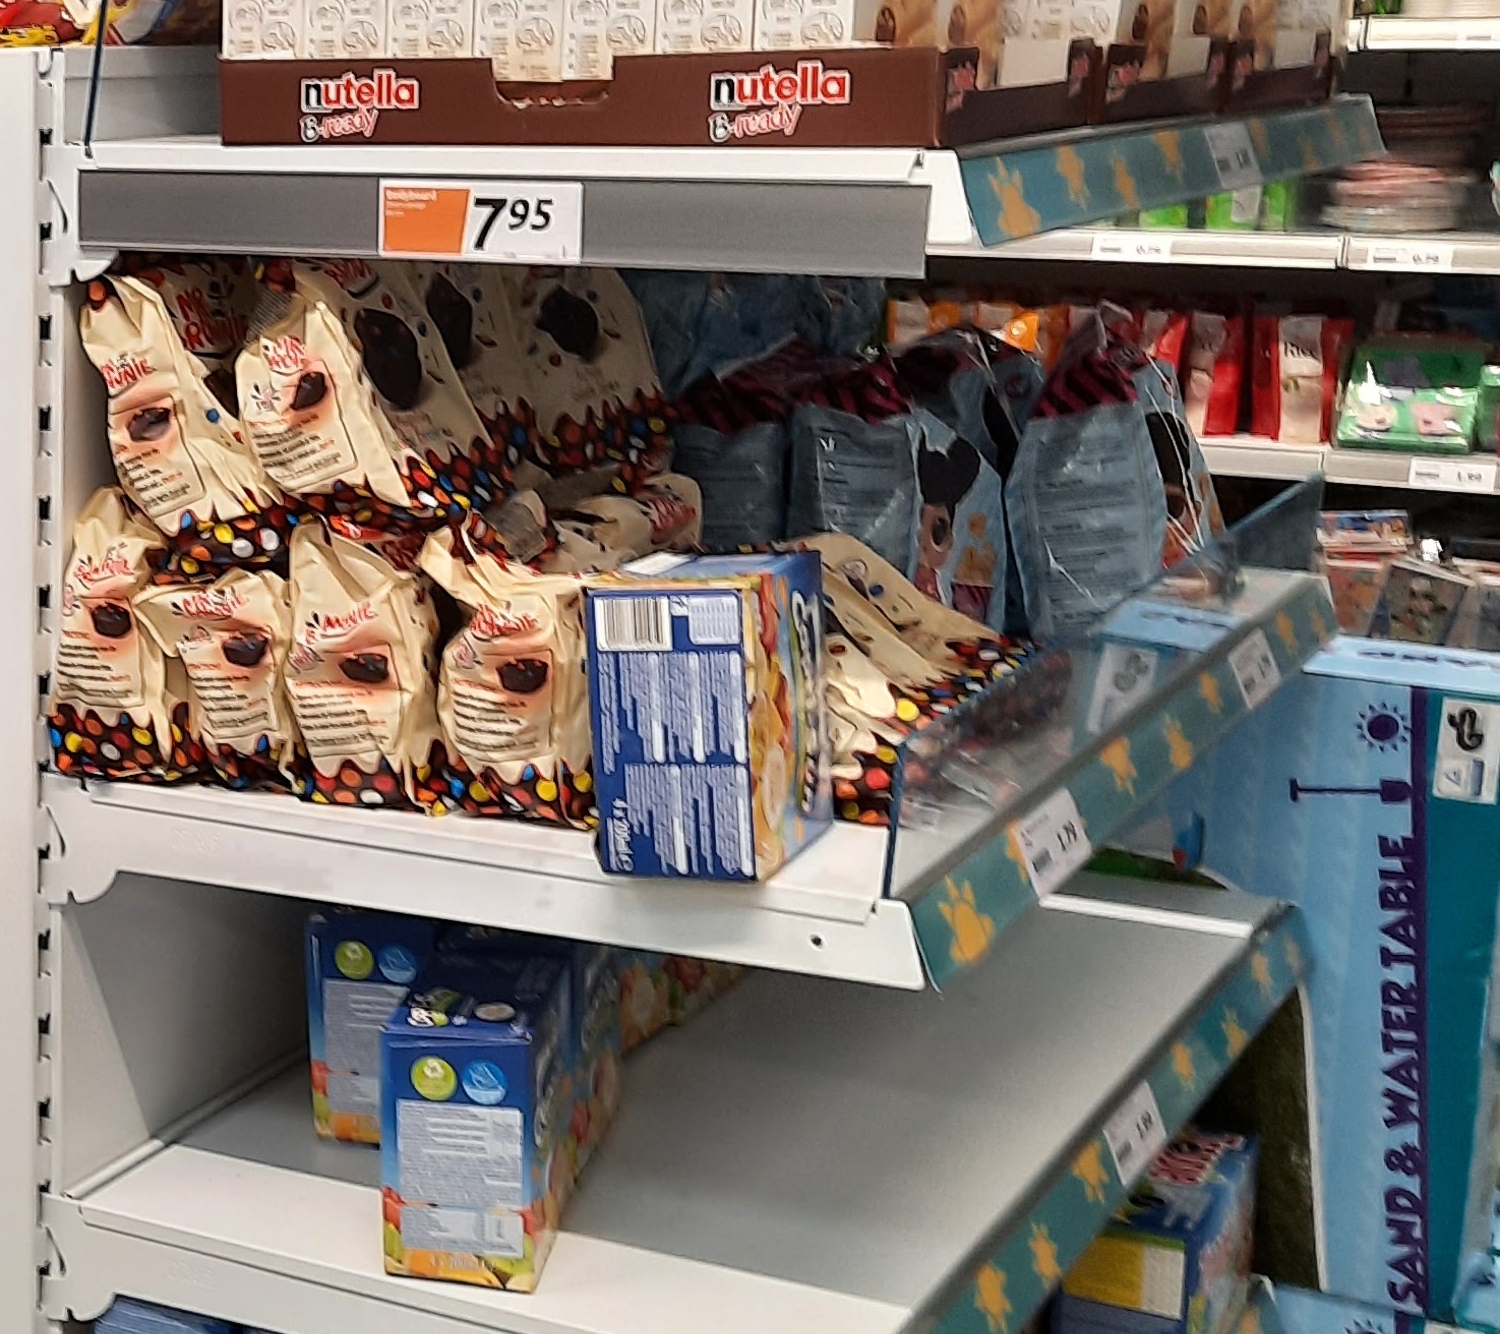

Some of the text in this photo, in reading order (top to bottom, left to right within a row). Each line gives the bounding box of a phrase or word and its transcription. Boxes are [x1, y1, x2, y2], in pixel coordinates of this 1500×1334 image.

[302, 67, 420, 114] nutella
[710, 59, 852, 111] nutella
[300, 107, 379, 143] B-ready
[707, 101, 802, 143] B-ready
[1377, 834, 1427, 1317] SAND & WATER TABLE
